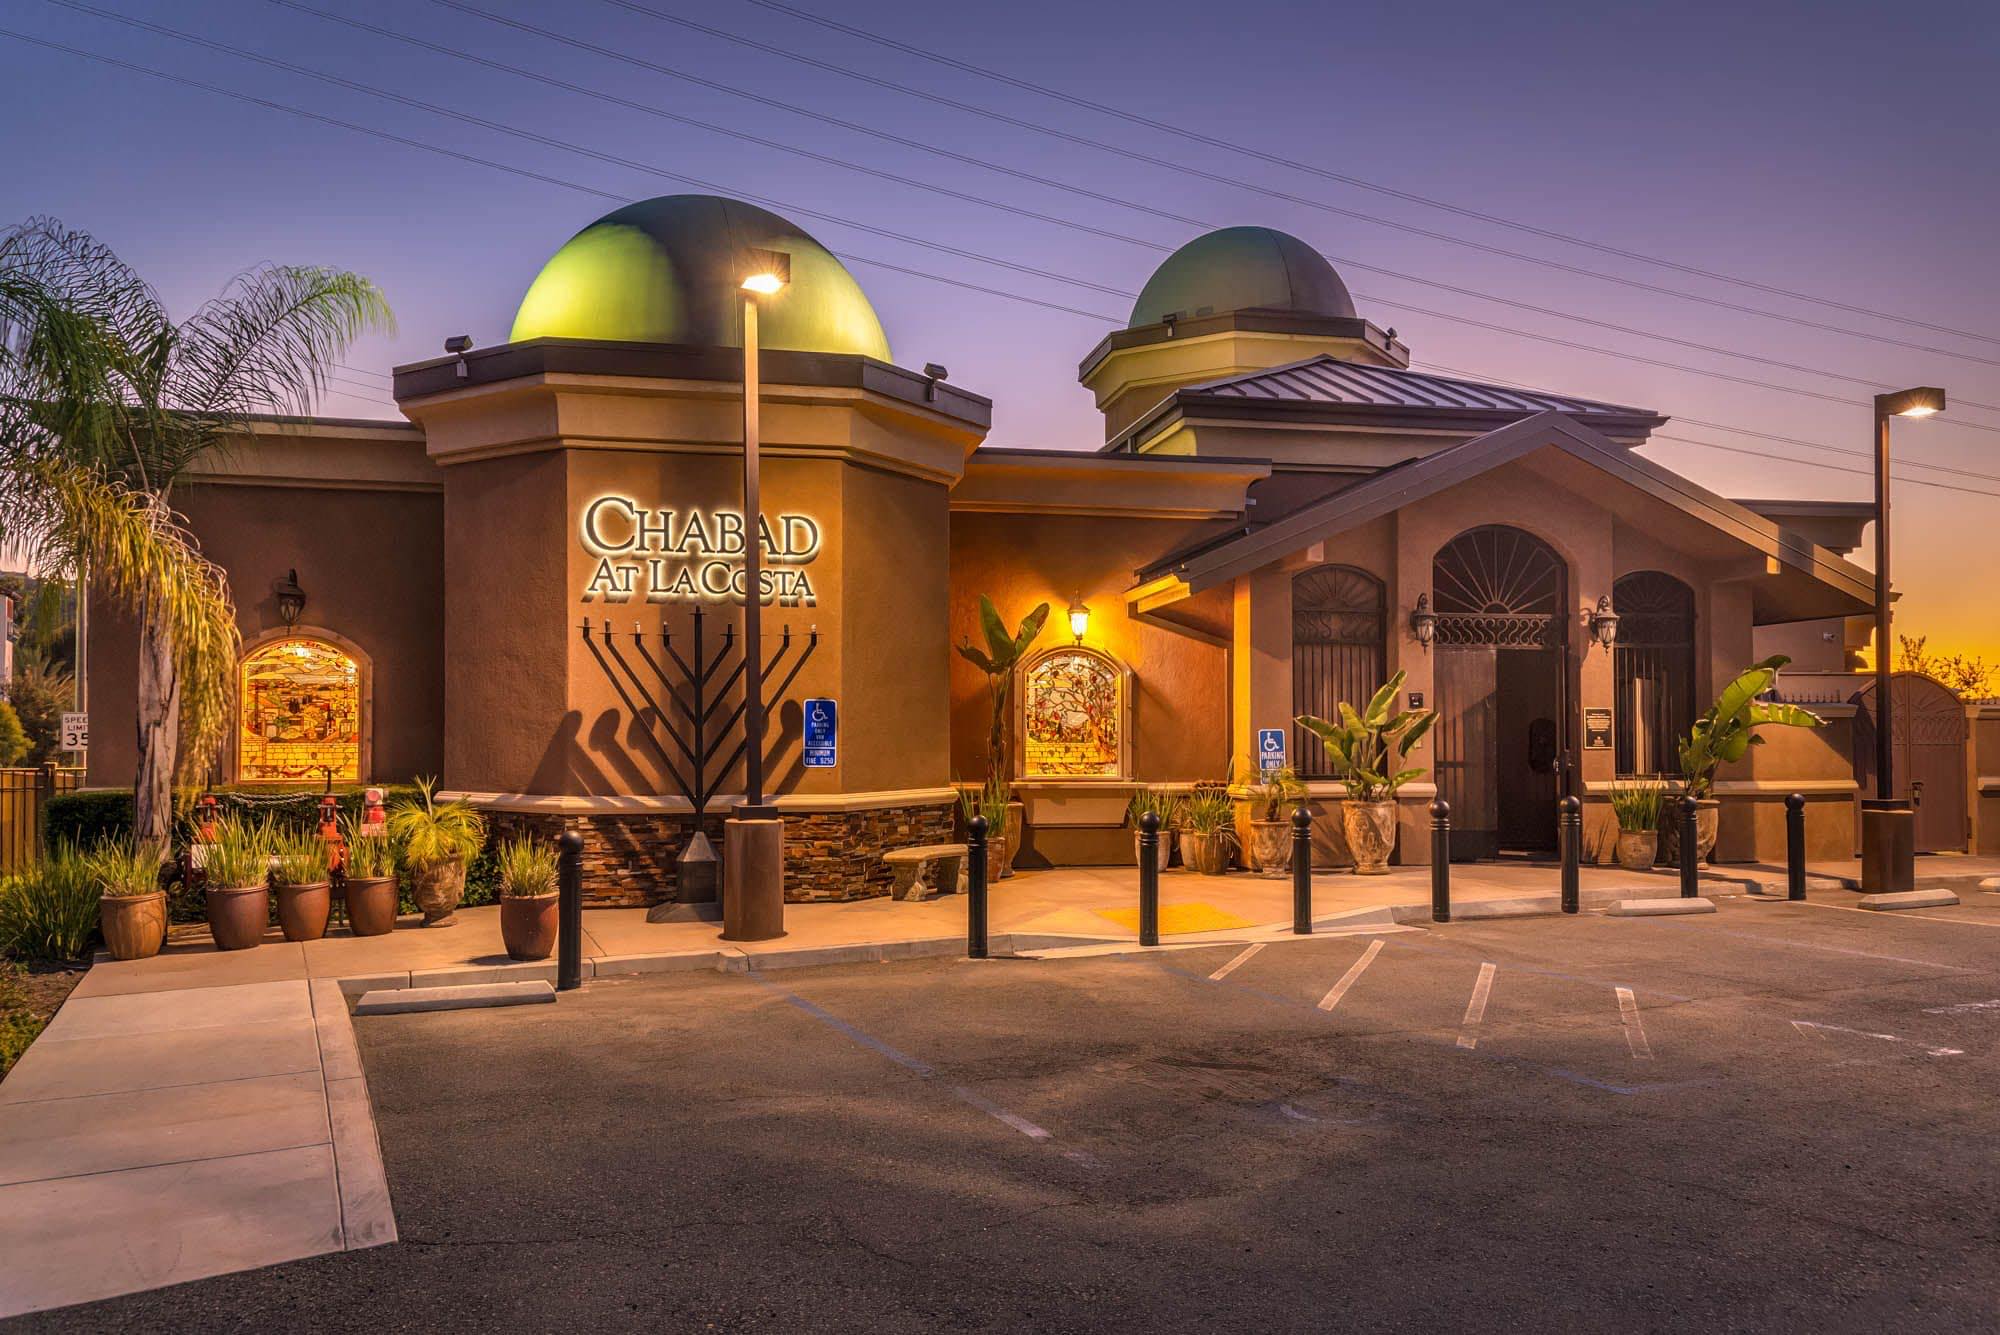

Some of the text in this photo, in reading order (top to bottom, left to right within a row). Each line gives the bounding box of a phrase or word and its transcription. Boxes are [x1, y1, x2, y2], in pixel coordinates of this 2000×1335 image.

[585, 496, 818, 556] CHABAD
[1261, 751, 1284, 760] PARKING
[1265, 760, 1281, 768] ONLY
